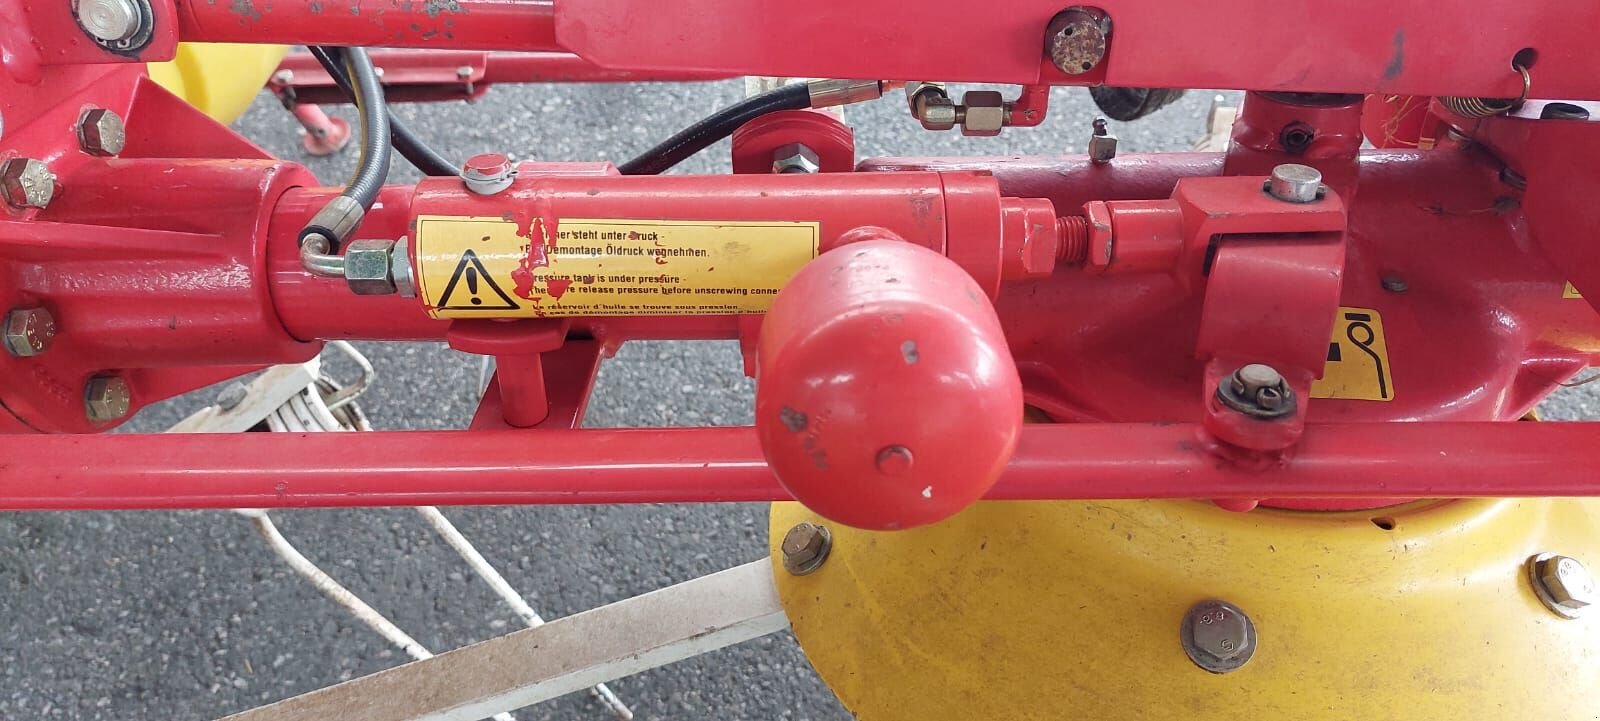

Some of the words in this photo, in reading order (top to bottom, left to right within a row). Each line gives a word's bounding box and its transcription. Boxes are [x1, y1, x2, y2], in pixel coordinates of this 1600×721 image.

[573, 230, 598, 240] steht
[601, 231, 627, 240] unter
[629, 231, 658, 241] ruck
[546, 244, 603, 257] Demontage
[606, 243, 644, 256] Öldruck
[647, 246, 710, 258] wegnehmen.
[597, 274, 606, 283] is
[608, 274, 636, 283] under
[579, 286, 614, 294] release
[618, 287, 659, 295] pressure
[661, 286, 692, 295] before
[695, 287, 748, 296] unscrewing
